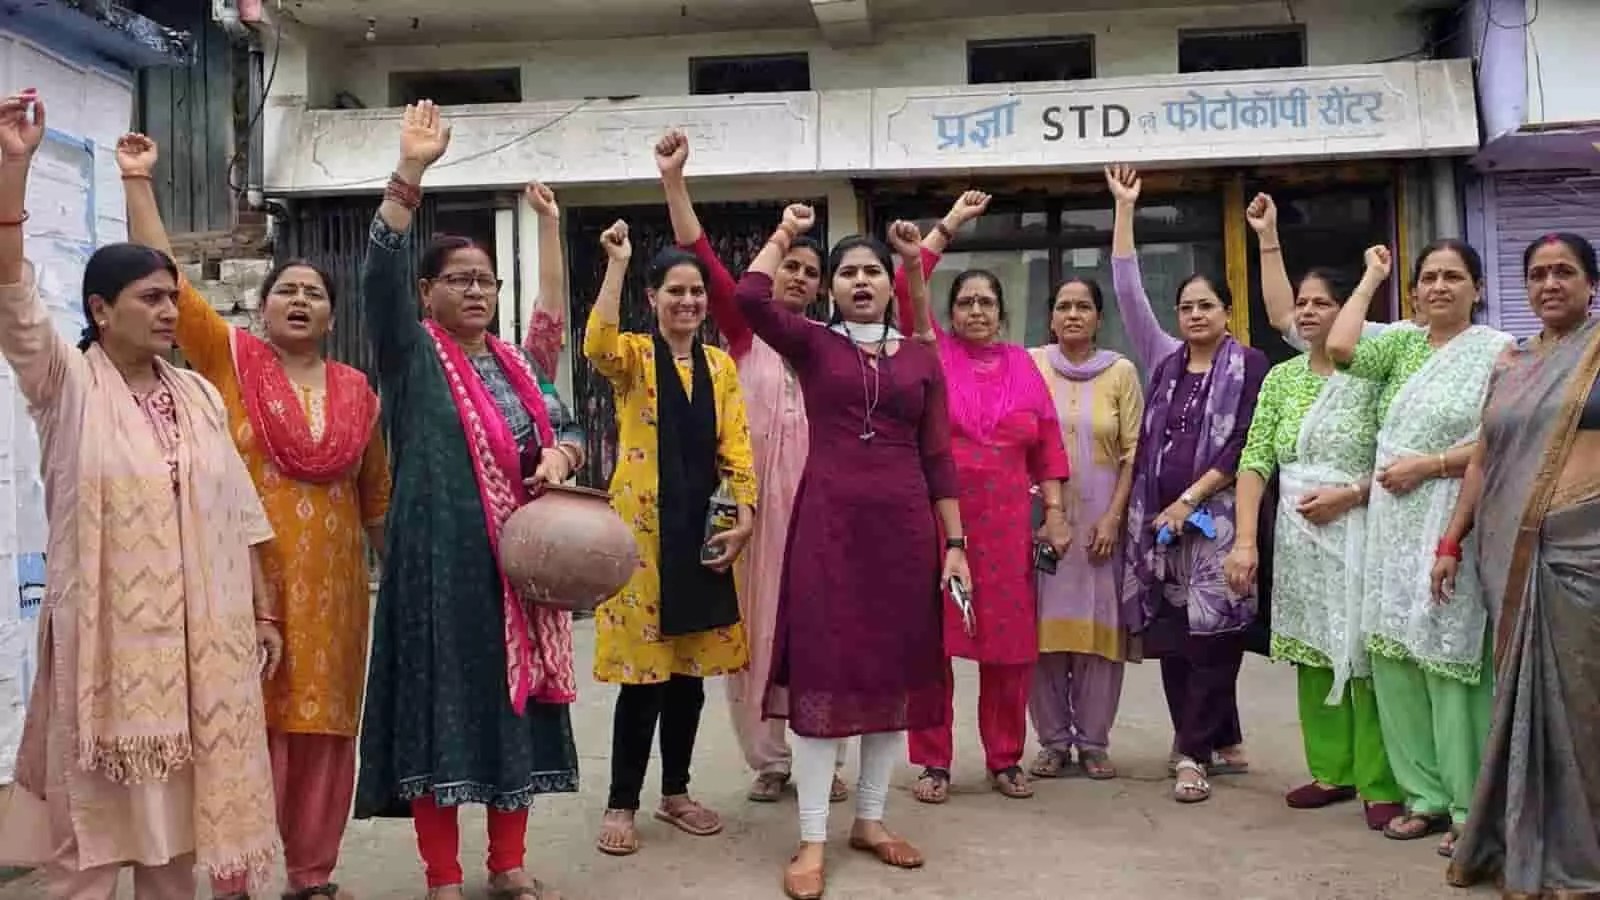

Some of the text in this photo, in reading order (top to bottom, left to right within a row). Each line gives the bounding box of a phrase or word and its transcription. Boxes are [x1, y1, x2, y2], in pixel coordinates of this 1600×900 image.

[1042, 103, 1131, 142] STD
[1161, 87, 1313, 132] फोटोकॉपी
[1317, 85, 1385, 126] सेंटर
